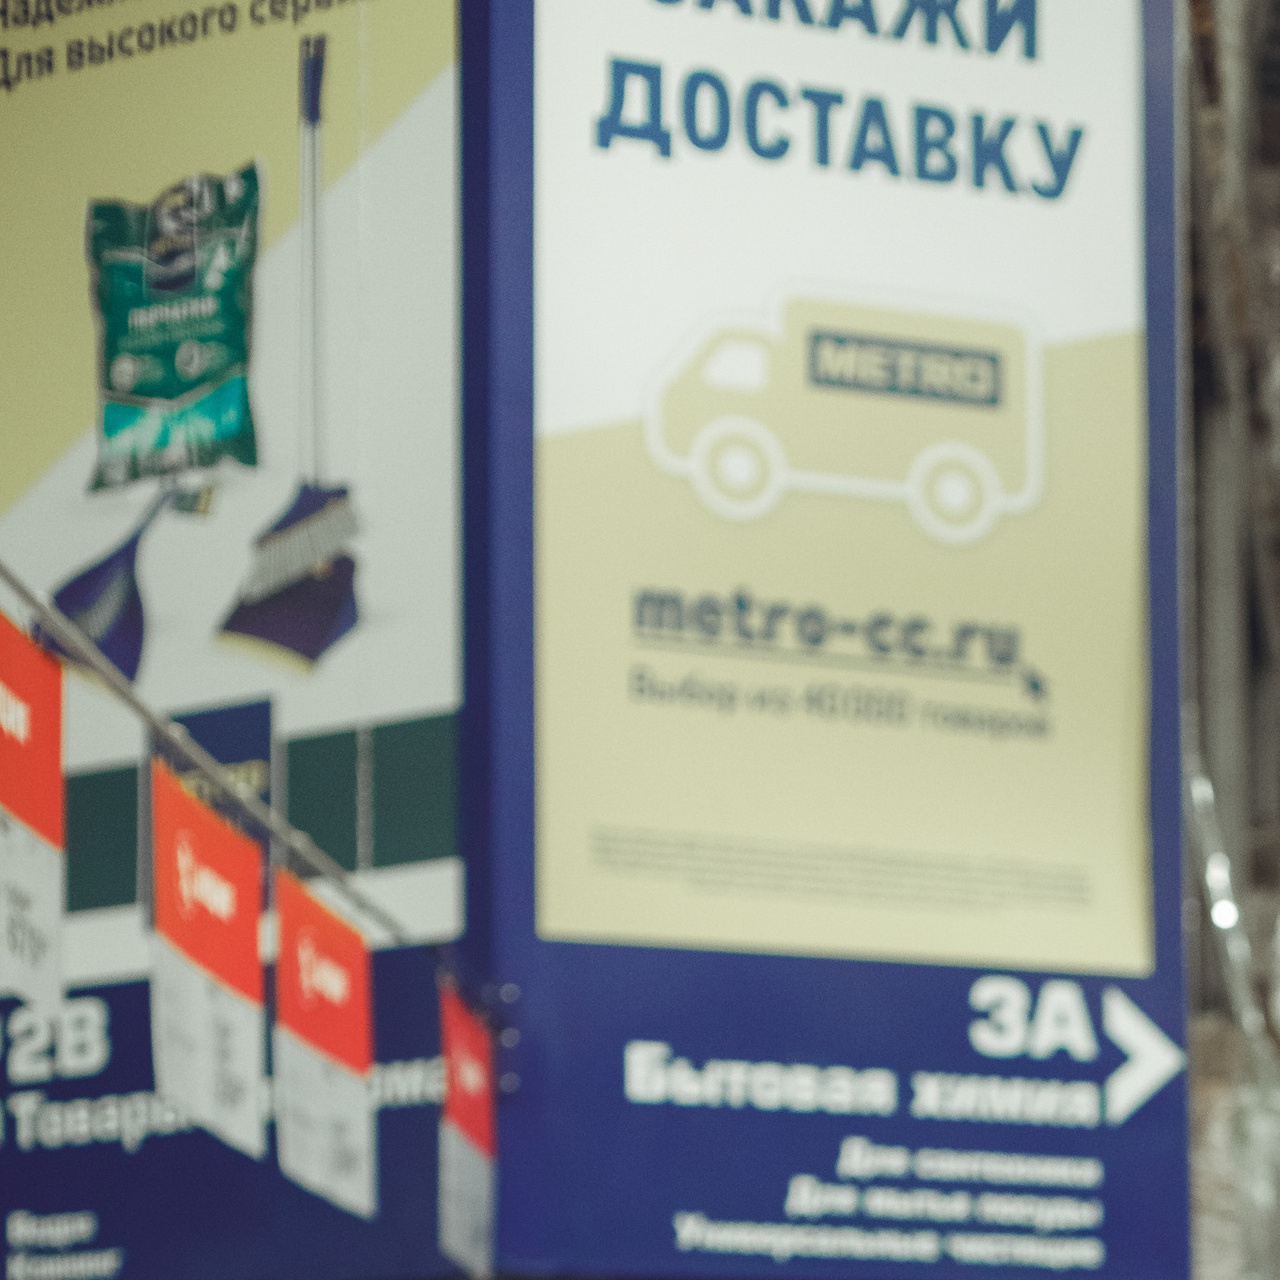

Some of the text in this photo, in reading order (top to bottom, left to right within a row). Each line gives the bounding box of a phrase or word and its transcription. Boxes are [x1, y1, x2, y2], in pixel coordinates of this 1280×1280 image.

[65, 2, 239, 71] высокого
[595, 55, 1085, 201] ДОСТАВКУ
[817, 340, 992, 398] METRO
[633, 588, 1021, 667] metro-cc.ru
[624, 1041, 1101, 1127] Бытовая химия
